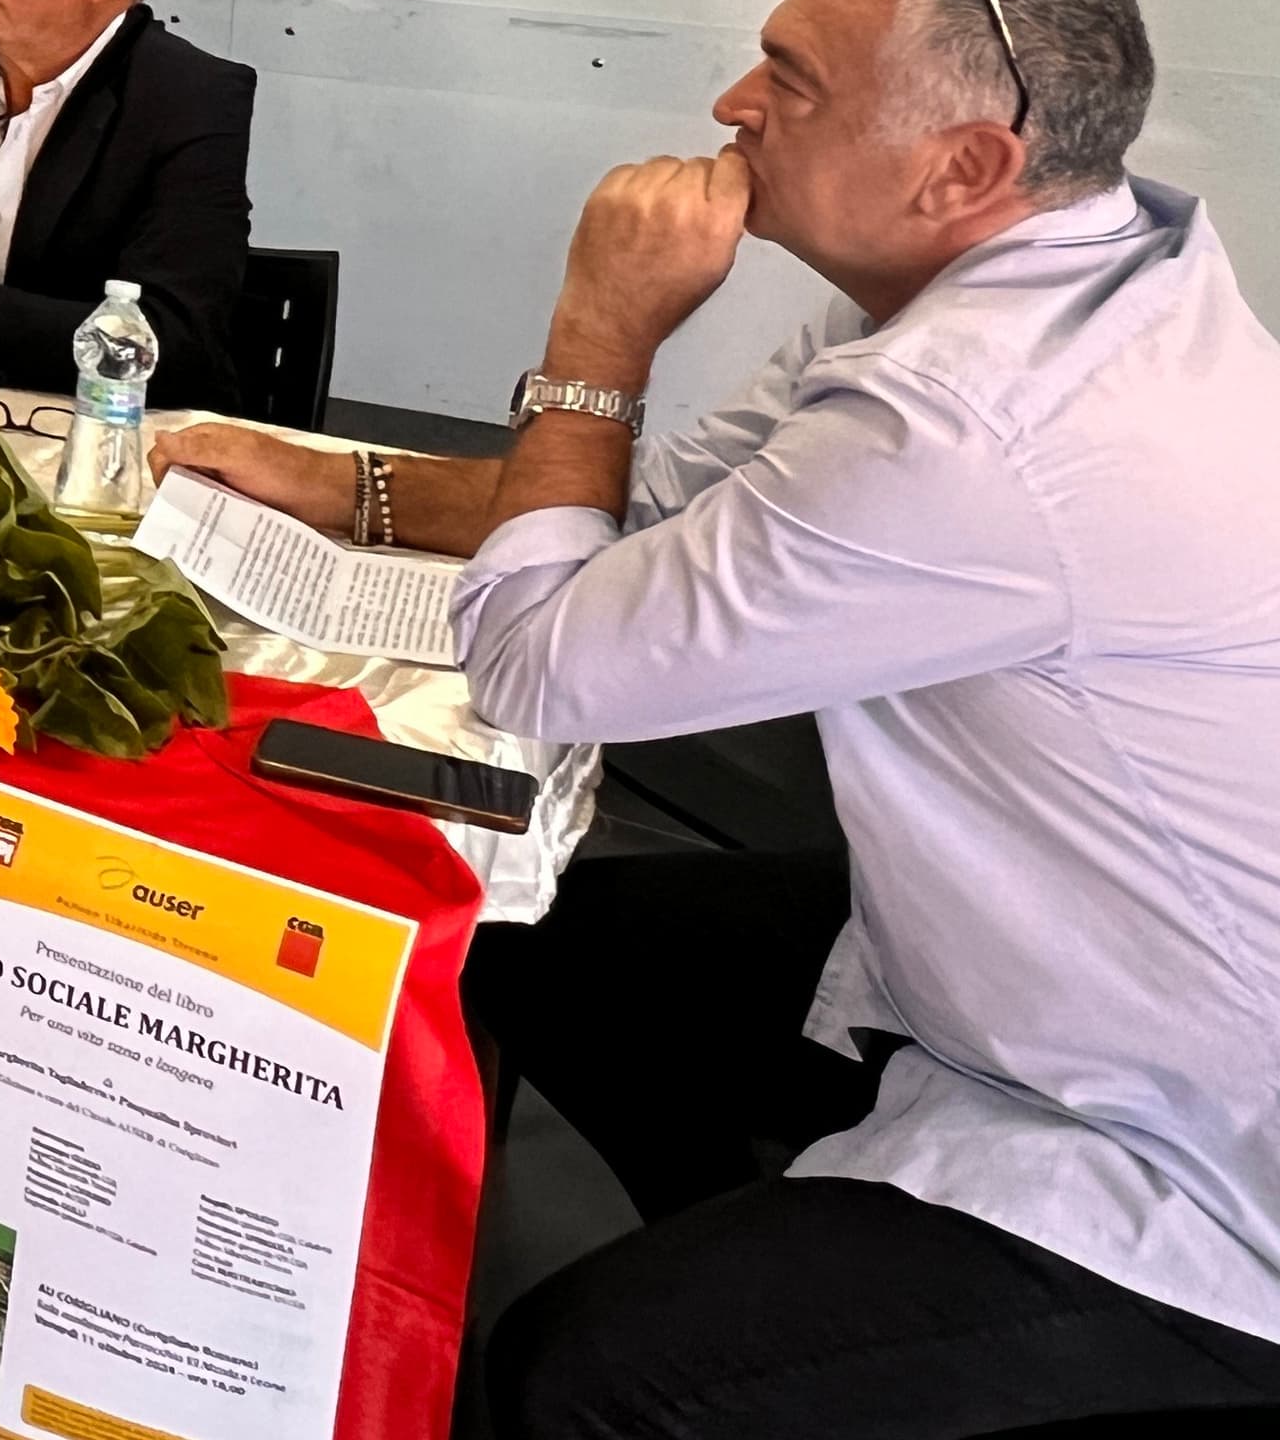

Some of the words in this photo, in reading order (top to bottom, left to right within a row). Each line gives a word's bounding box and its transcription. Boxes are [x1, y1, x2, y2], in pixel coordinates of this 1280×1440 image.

[131, 883, 205, 921] auser
[35, 939, 144, 993] Presentazione
[147, 982, 173, 1004] del
[176, 992, 215, 1019] libro
[10, 965, 132, 1030] SOCIALE
[137, 1011, 345, 1111] MARGHERITA
